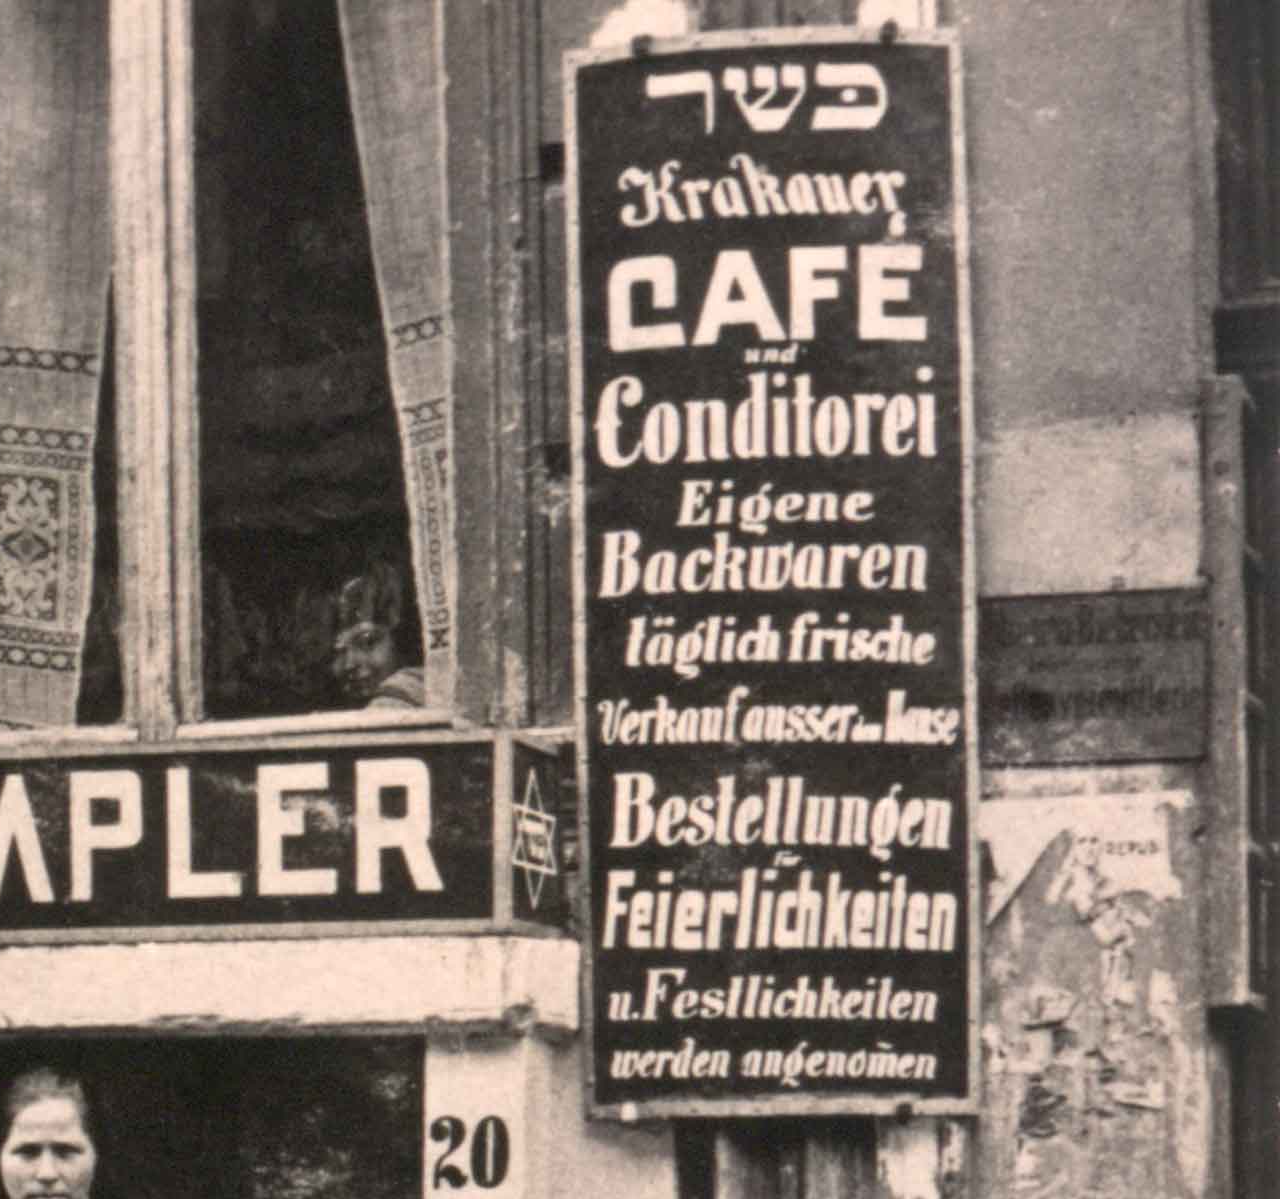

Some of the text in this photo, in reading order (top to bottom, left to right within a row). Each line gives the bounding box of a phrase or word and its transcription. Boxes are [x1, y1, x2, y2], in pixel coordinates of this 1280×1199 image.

[619, 154, 906, 228] Krakauer
[608, 209, 927, 351] CAFÉ
[746, 344, 797, 362] und
[595, 367, 936, 467] Conditorei
[678, 480, 872, 535] Eigene
[600, 530, 926, 597] Backwaren
[627, 616, 780, 678] täglich
[789, 612, 935, 664] frische
[598, 686, 749, 744] Verkauf
[611, 773, 951, 864] Bestellungen
[603, 868, 956, 950] Feierlichkeiten
[612, 1038, 729, 1077] werden
[431, 1117, 508, 1188] 20
